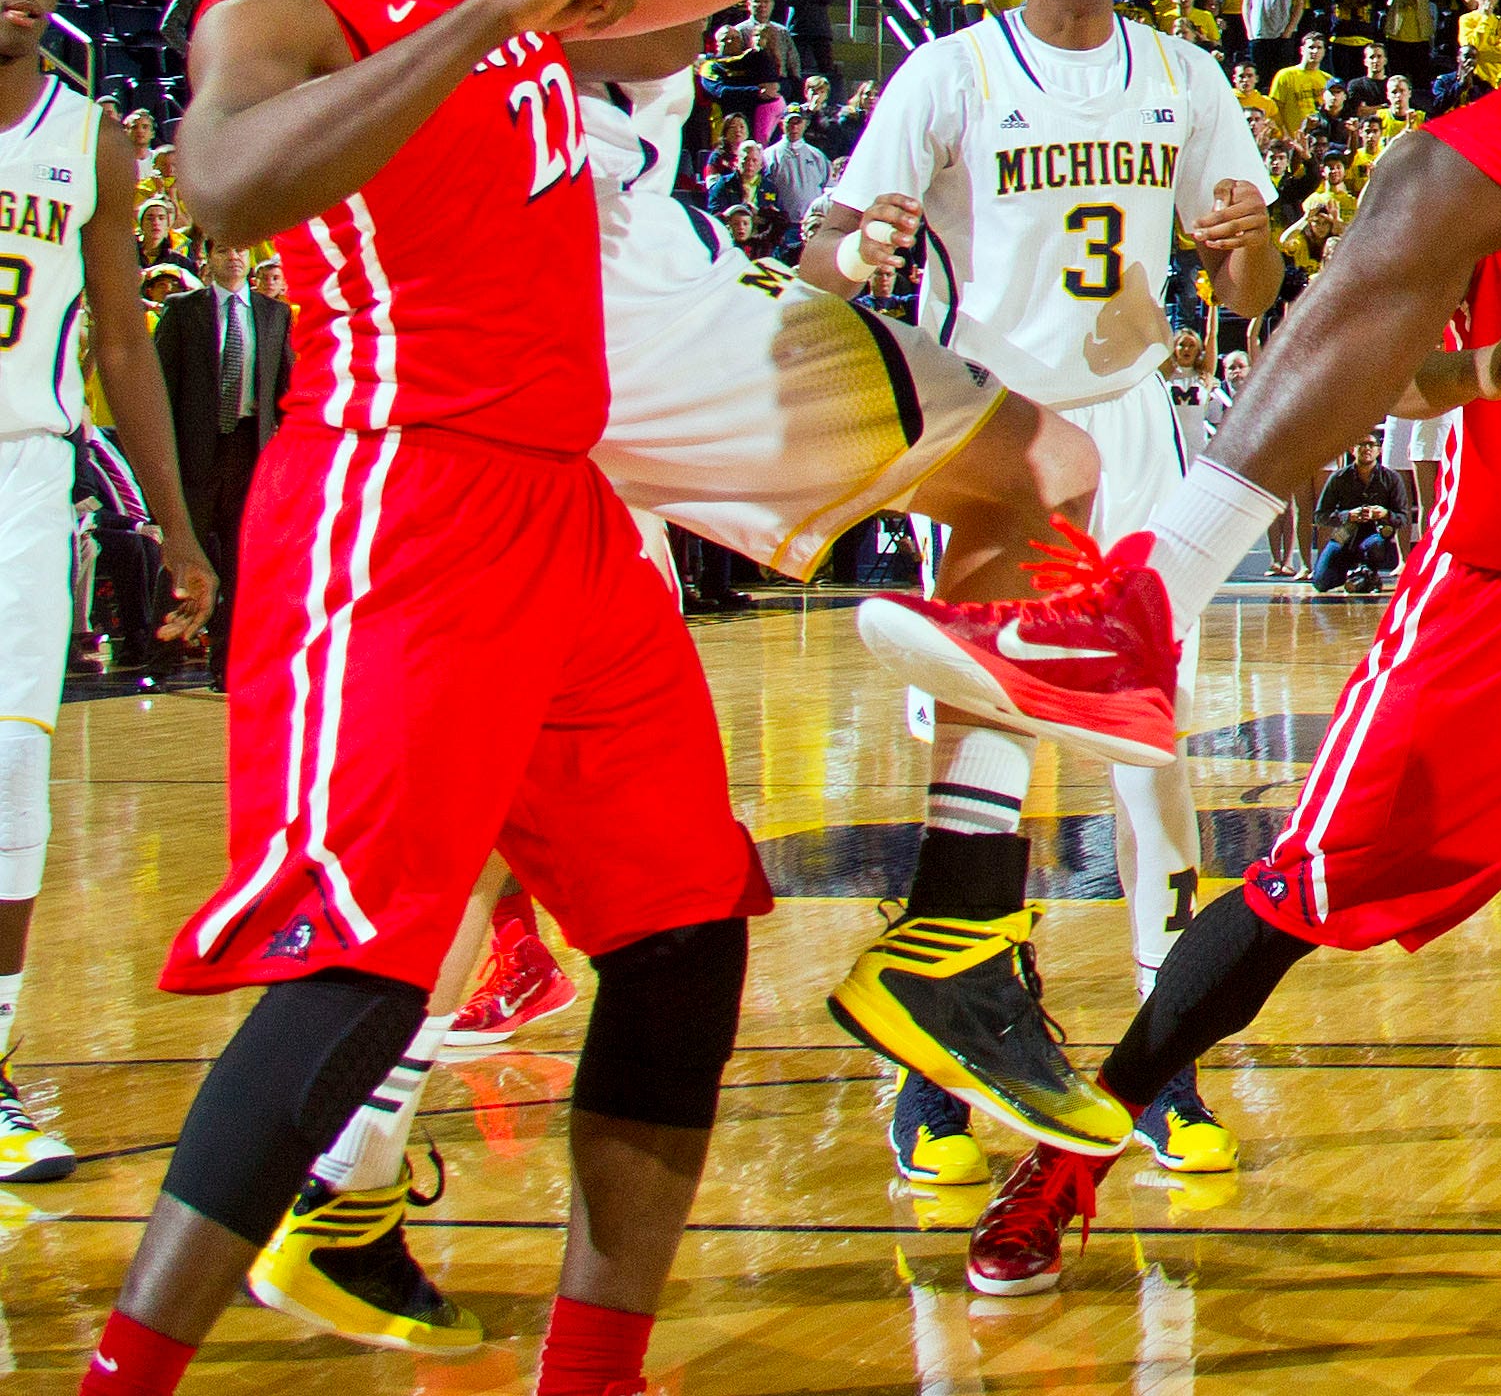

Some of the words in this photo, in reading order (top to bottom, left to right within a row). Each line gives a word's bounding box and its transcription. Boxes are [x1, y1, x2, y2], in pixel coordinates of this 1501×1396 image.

[508, 63, 588, 205] 22
[996, 141, 1179, 196] MICHIGAN
[737, 259, 796, 299] M
[1062, 202, 1126, 302] 3
